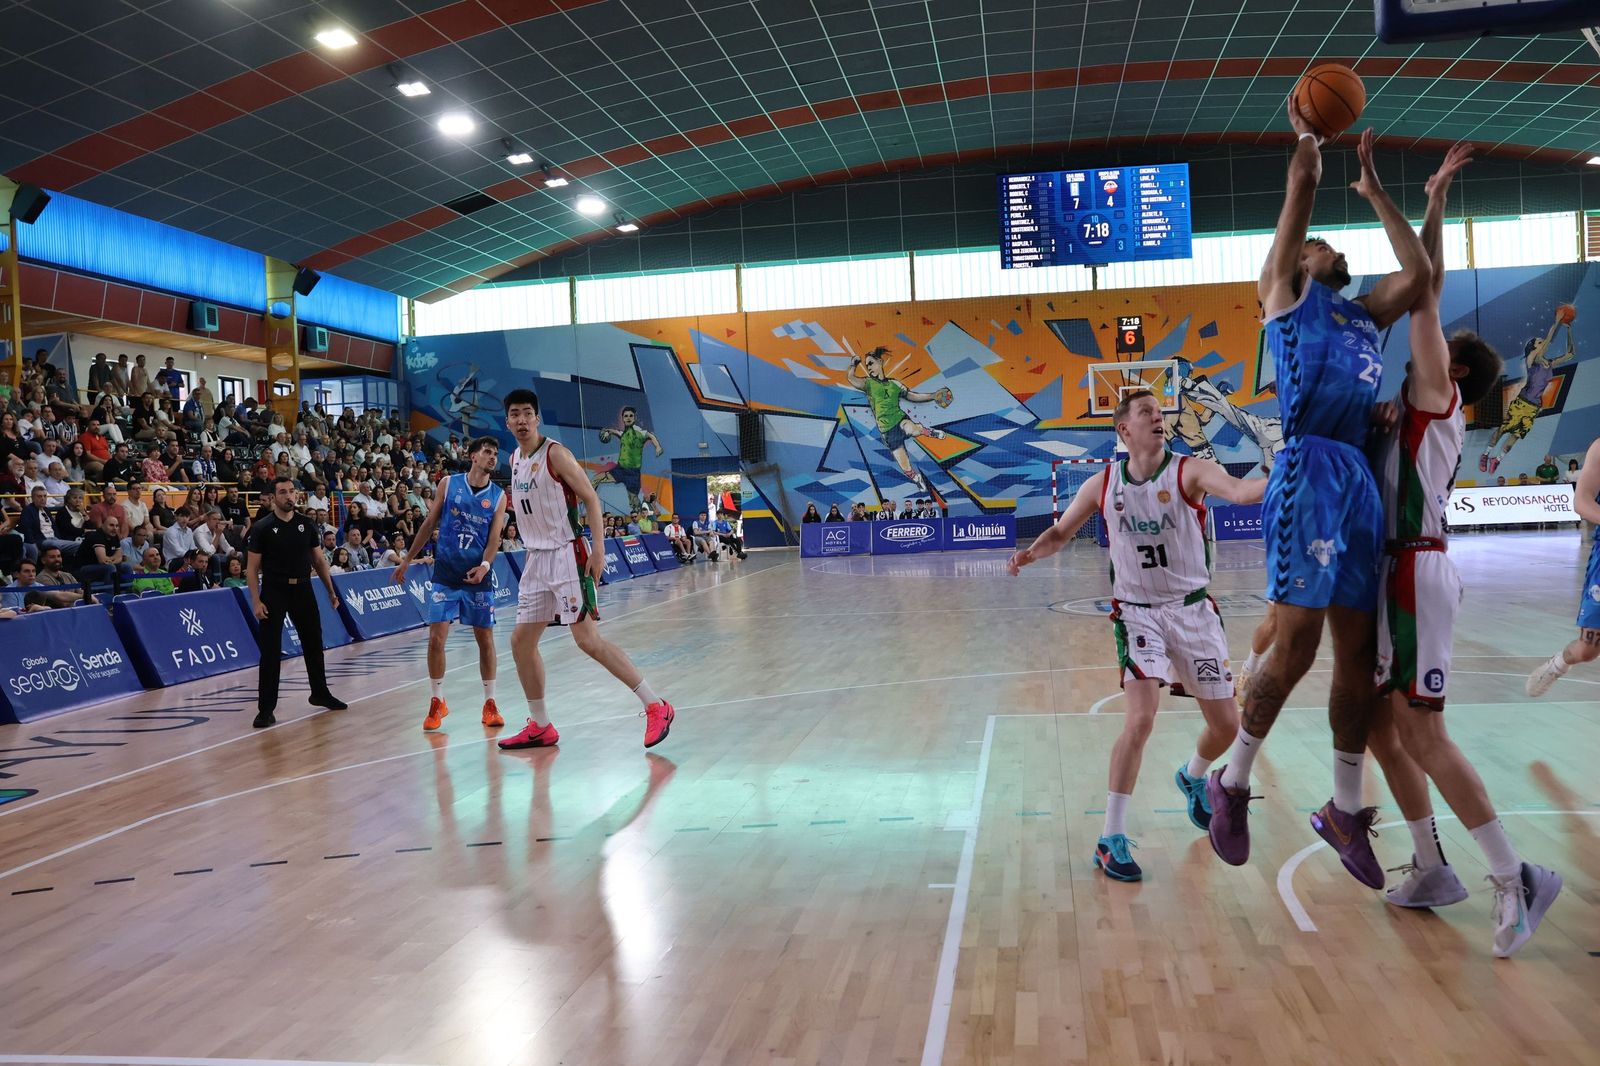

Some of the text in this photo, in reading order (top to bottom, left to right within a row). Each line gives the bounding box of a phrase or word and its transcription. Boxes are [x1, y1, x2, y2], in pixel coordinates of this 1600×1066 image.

[1073, 197, 1079, 209] 7
[1107, 195, 1114, 207] 4
[1091, 215, 1098, 223] 10
[1083, 223, 1109, 238] 7:18
[1118, 240, 1123, 250] 3
[1122, 317, 1140, 325] 7:18
[1125, 330, 1136, 345] 6
[520, 499, 533, 515] 11
[1482, 494, 1570, 507] REYDONSANCHO
[1544, 504, 1572, 513] HOTEL
[825, 530, 846, 541] AC
[886, 527, 928, 538] FERRERO
[952, 521, 1006, 538] La Opinión
[457, 533, 474, 550] 17
[1136, 543, 1168, 569] 31
[364, 584, 406, 601] CAJA RURAL
[370, 598, 402, 612] DE ZAMORA
[80, 647, 122, 670] Senda
[171, 640, 239, 669] FADIS
[22, 655, 48, 670] Cobadu
